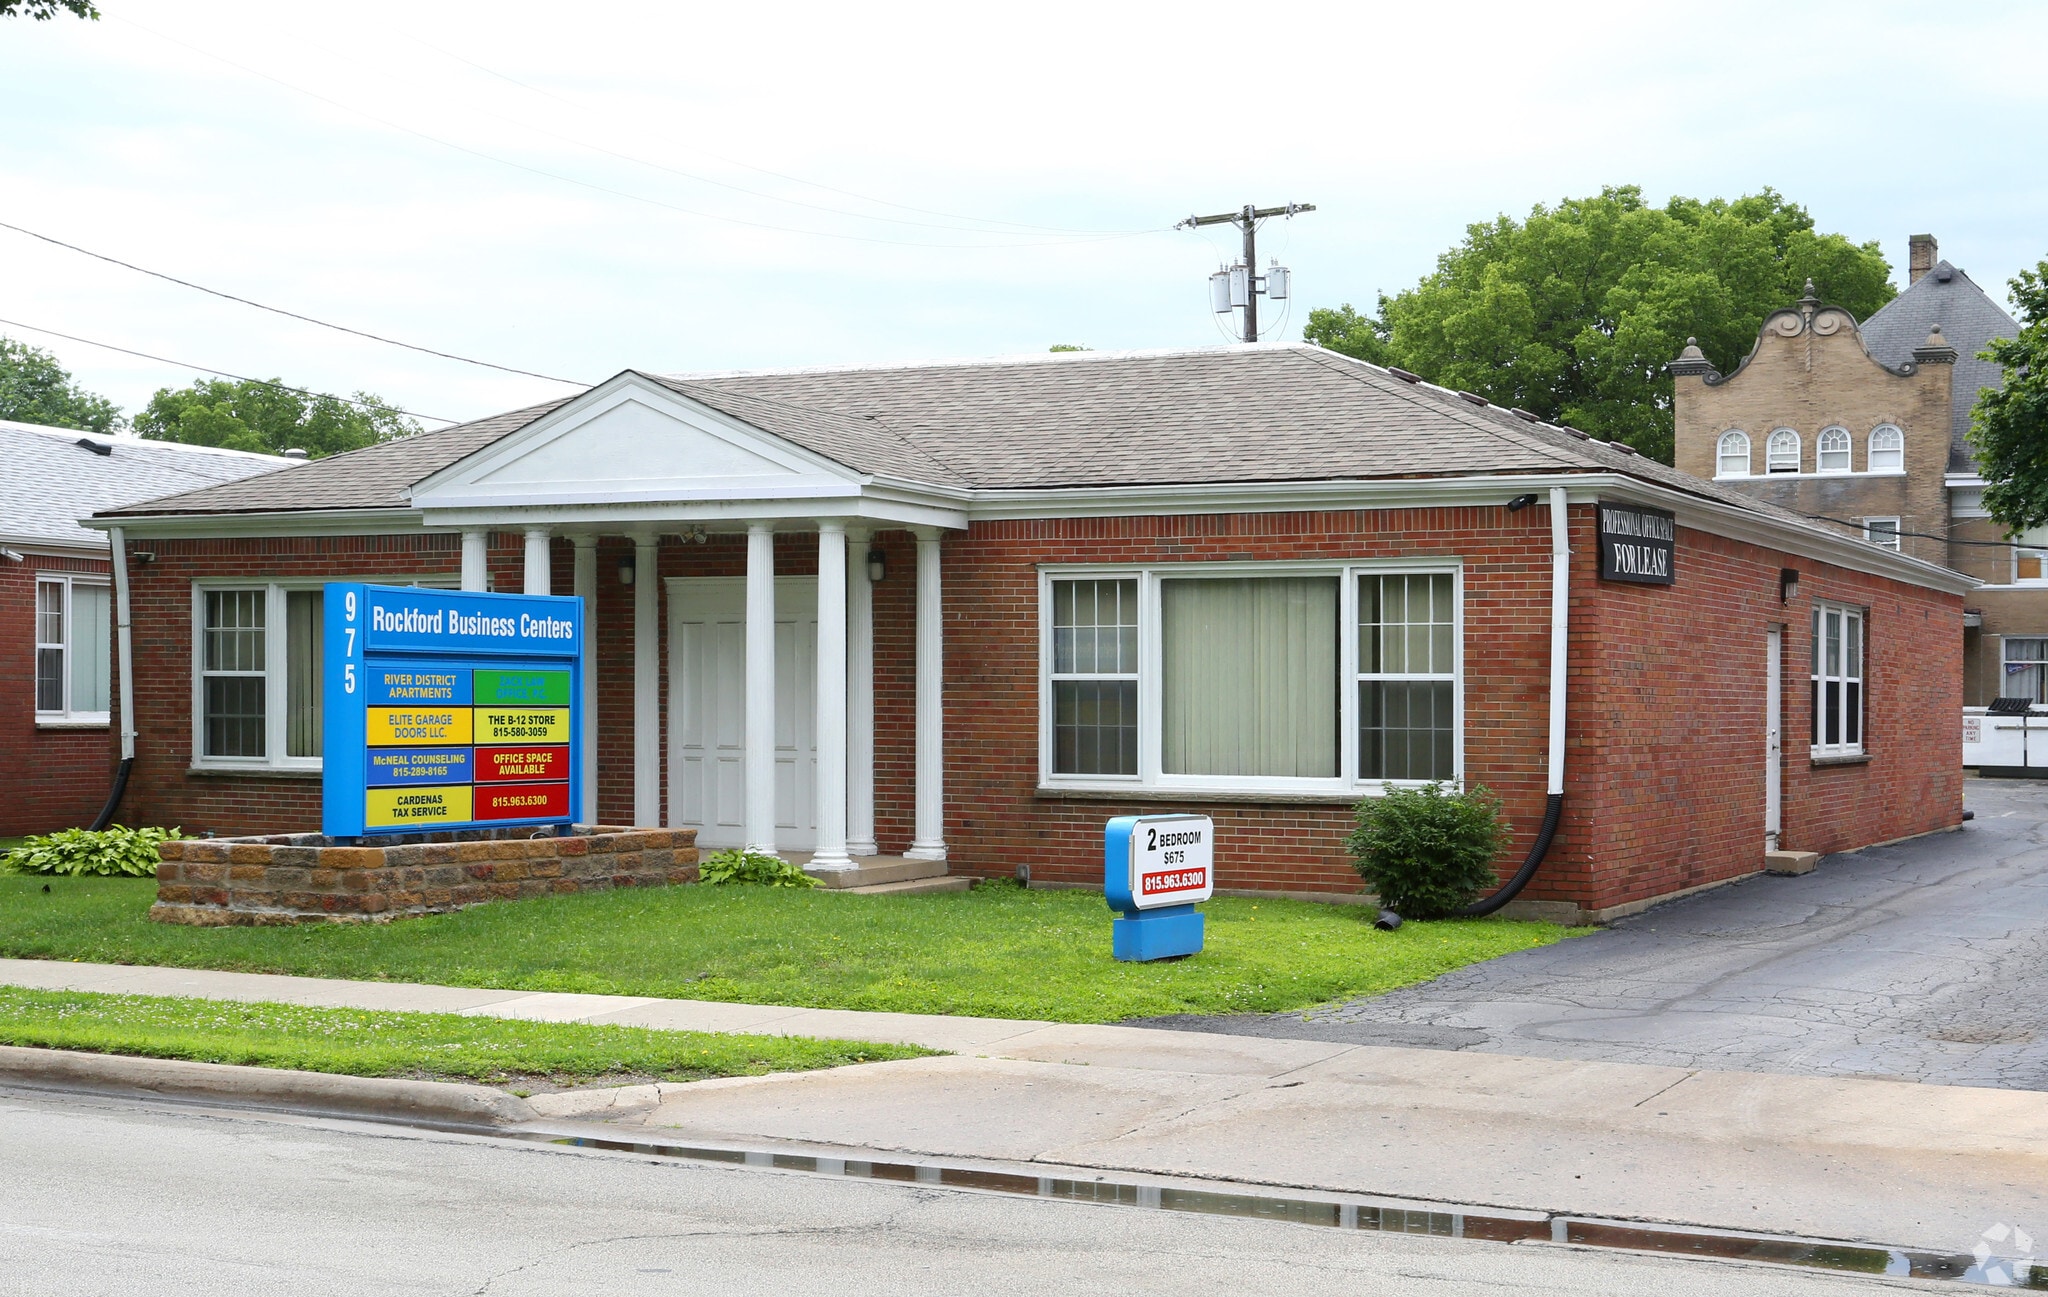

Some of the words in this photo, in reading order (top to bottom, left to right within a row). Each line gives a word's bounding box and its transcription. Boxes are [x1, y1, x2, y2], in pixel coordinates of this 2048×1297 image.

[1602, 508, 1641, 537] PROFESSIONAL
[1641, 513, 1660, 540] OFFICE
[1613, 542, 1637, 574] FOR
[1637, 545, 1668, 577] LEASE
[373, 605, 442, 634] Rockford
[449, 609, 515, 637] Business
[520, 613, 573, 639] Centers
[384, 674, 412, 685] RIVER
[415, 674, 457, 686] DISTRICT
[525, 676, 546, 687] LAW
[388, 687, 452, 698] APARTMENTS
[389, 714, 413, 725] ELITE
[415, 714, 453, 725] GARAGE
[488, 715, 505, 725] THE
[508, 715, 526, 725] B-12
[528, 715, 555, 725] STORE
[395, 727, 427, 738] DOORS
[429, 727, 447, 738] LLC.
[493, 727, 548, 737] 815-580-3059
[373, 755, 409, 766] McNEAL
[411, 754, 465, 765] COUNSELING
[493, 753, 524, 764] OFFICE
[526, 752, 553, 763] SPACE
[393, 766, 448, 777] 815-289-8165
[499, 764, 545, 775] AVAILABLE
[397, 794, 443, 806] CARDENAS
[492, 795, 548, 808] 815.963.6300
[392, 808, 409, 818] TAX
[411, 806, 447, 817] SERVICE
[1147, 828, 1157, 852] 2
[1159, 830, 1202, 848] BEDROOM
[1163, 850, 1185, 865] $675
[1144, 871, 1204, 891] 815.963.6300
